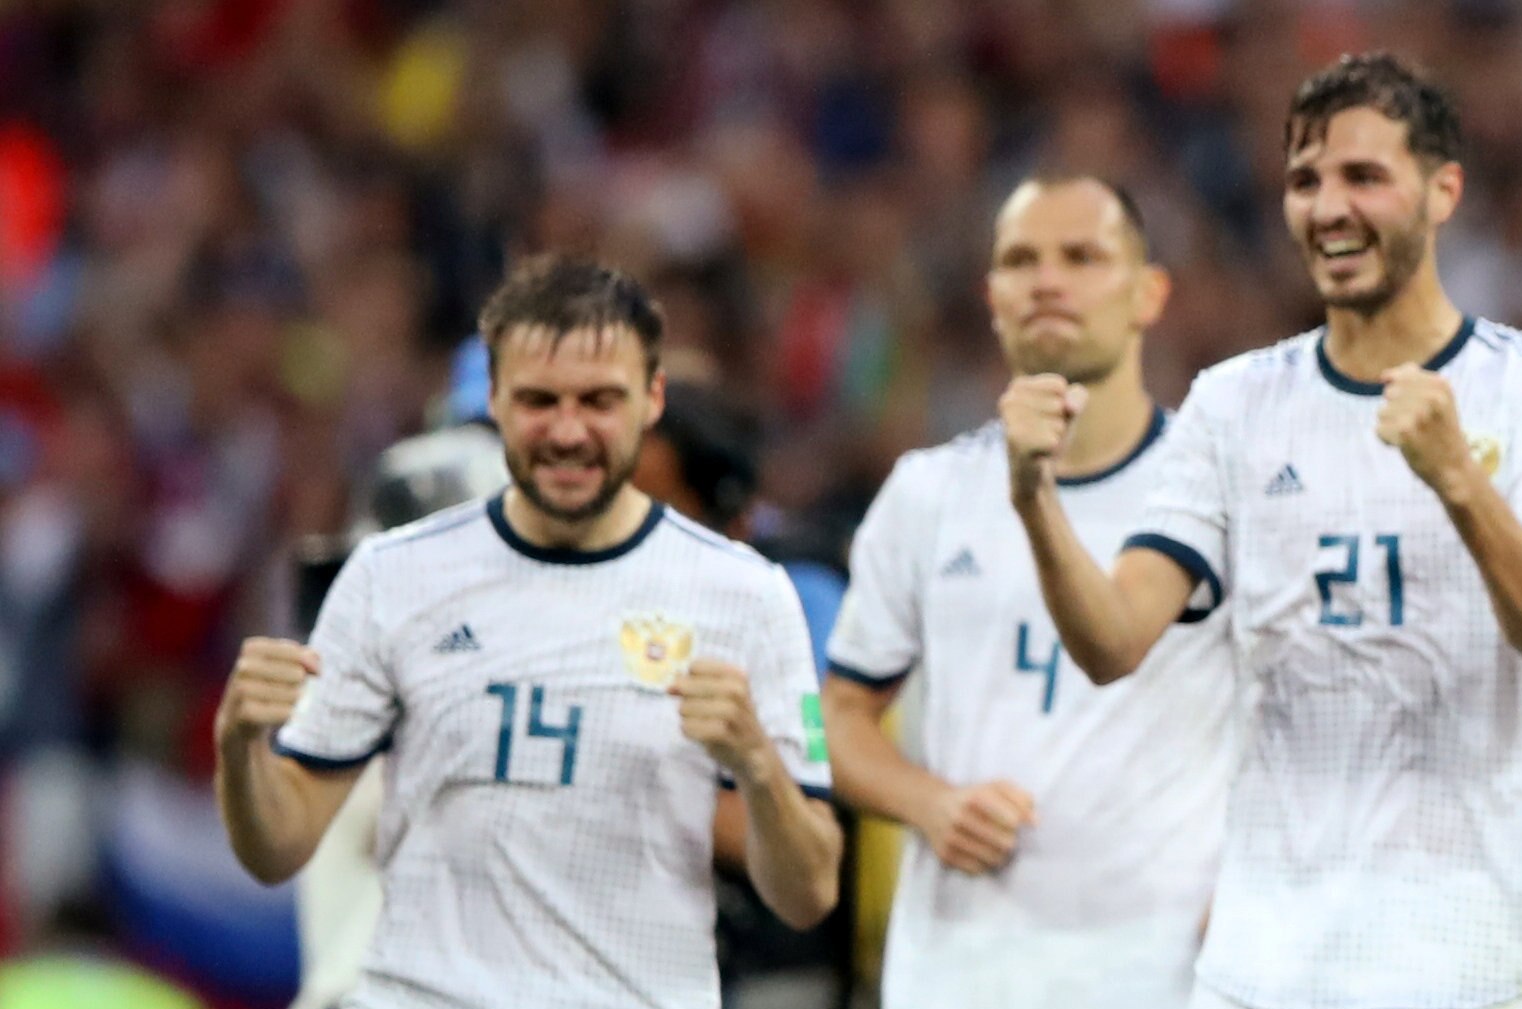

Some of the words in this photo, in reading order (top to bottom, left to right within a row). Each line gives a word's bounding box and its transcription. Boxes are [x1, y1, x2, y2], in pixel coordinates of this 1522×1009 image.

[1314, 534, 1404, 626] 21
[1014, 621, 1058, 714] 4
[486, 683, 582, 786] 14
